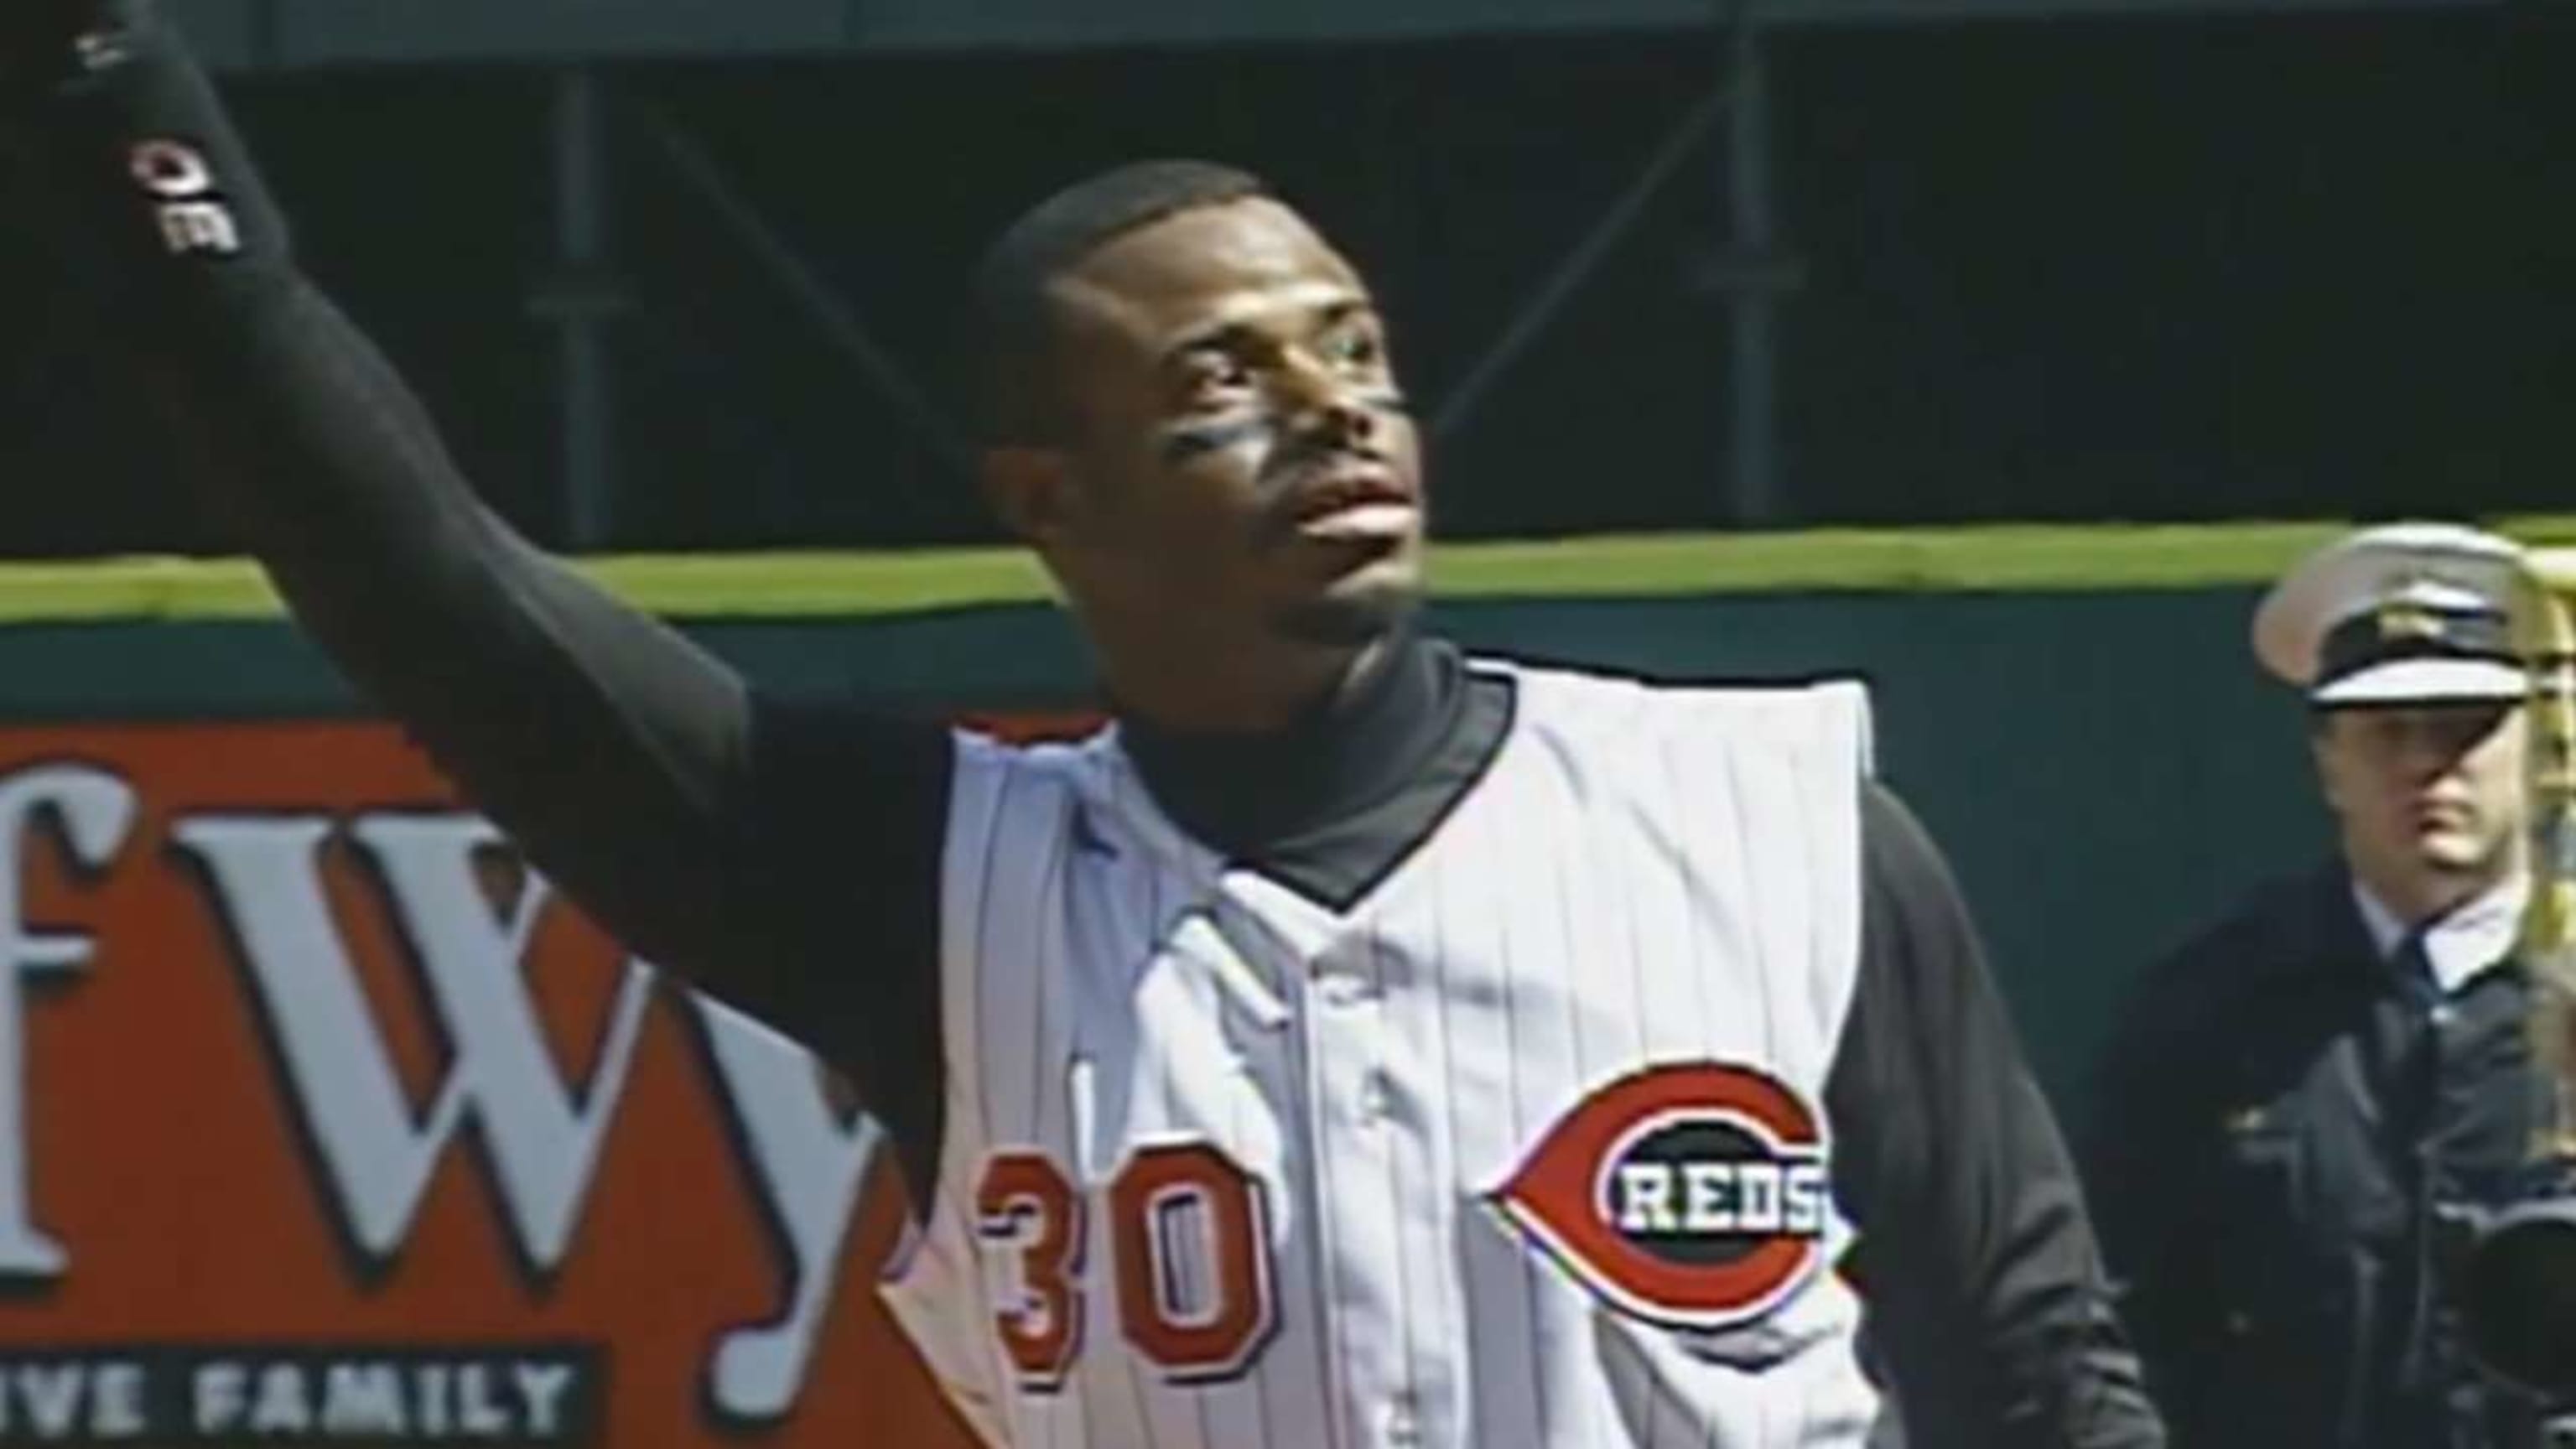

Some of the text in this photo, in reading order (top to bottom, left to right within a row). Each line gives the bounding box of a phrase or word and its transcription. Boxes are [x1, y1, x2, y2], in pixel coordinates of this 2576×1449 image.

[1618, 1161, 1825, 1233] REDS
[974, 1142, 1283, 1392] 30
[193, 1360, 572, 1437] FAMILY
